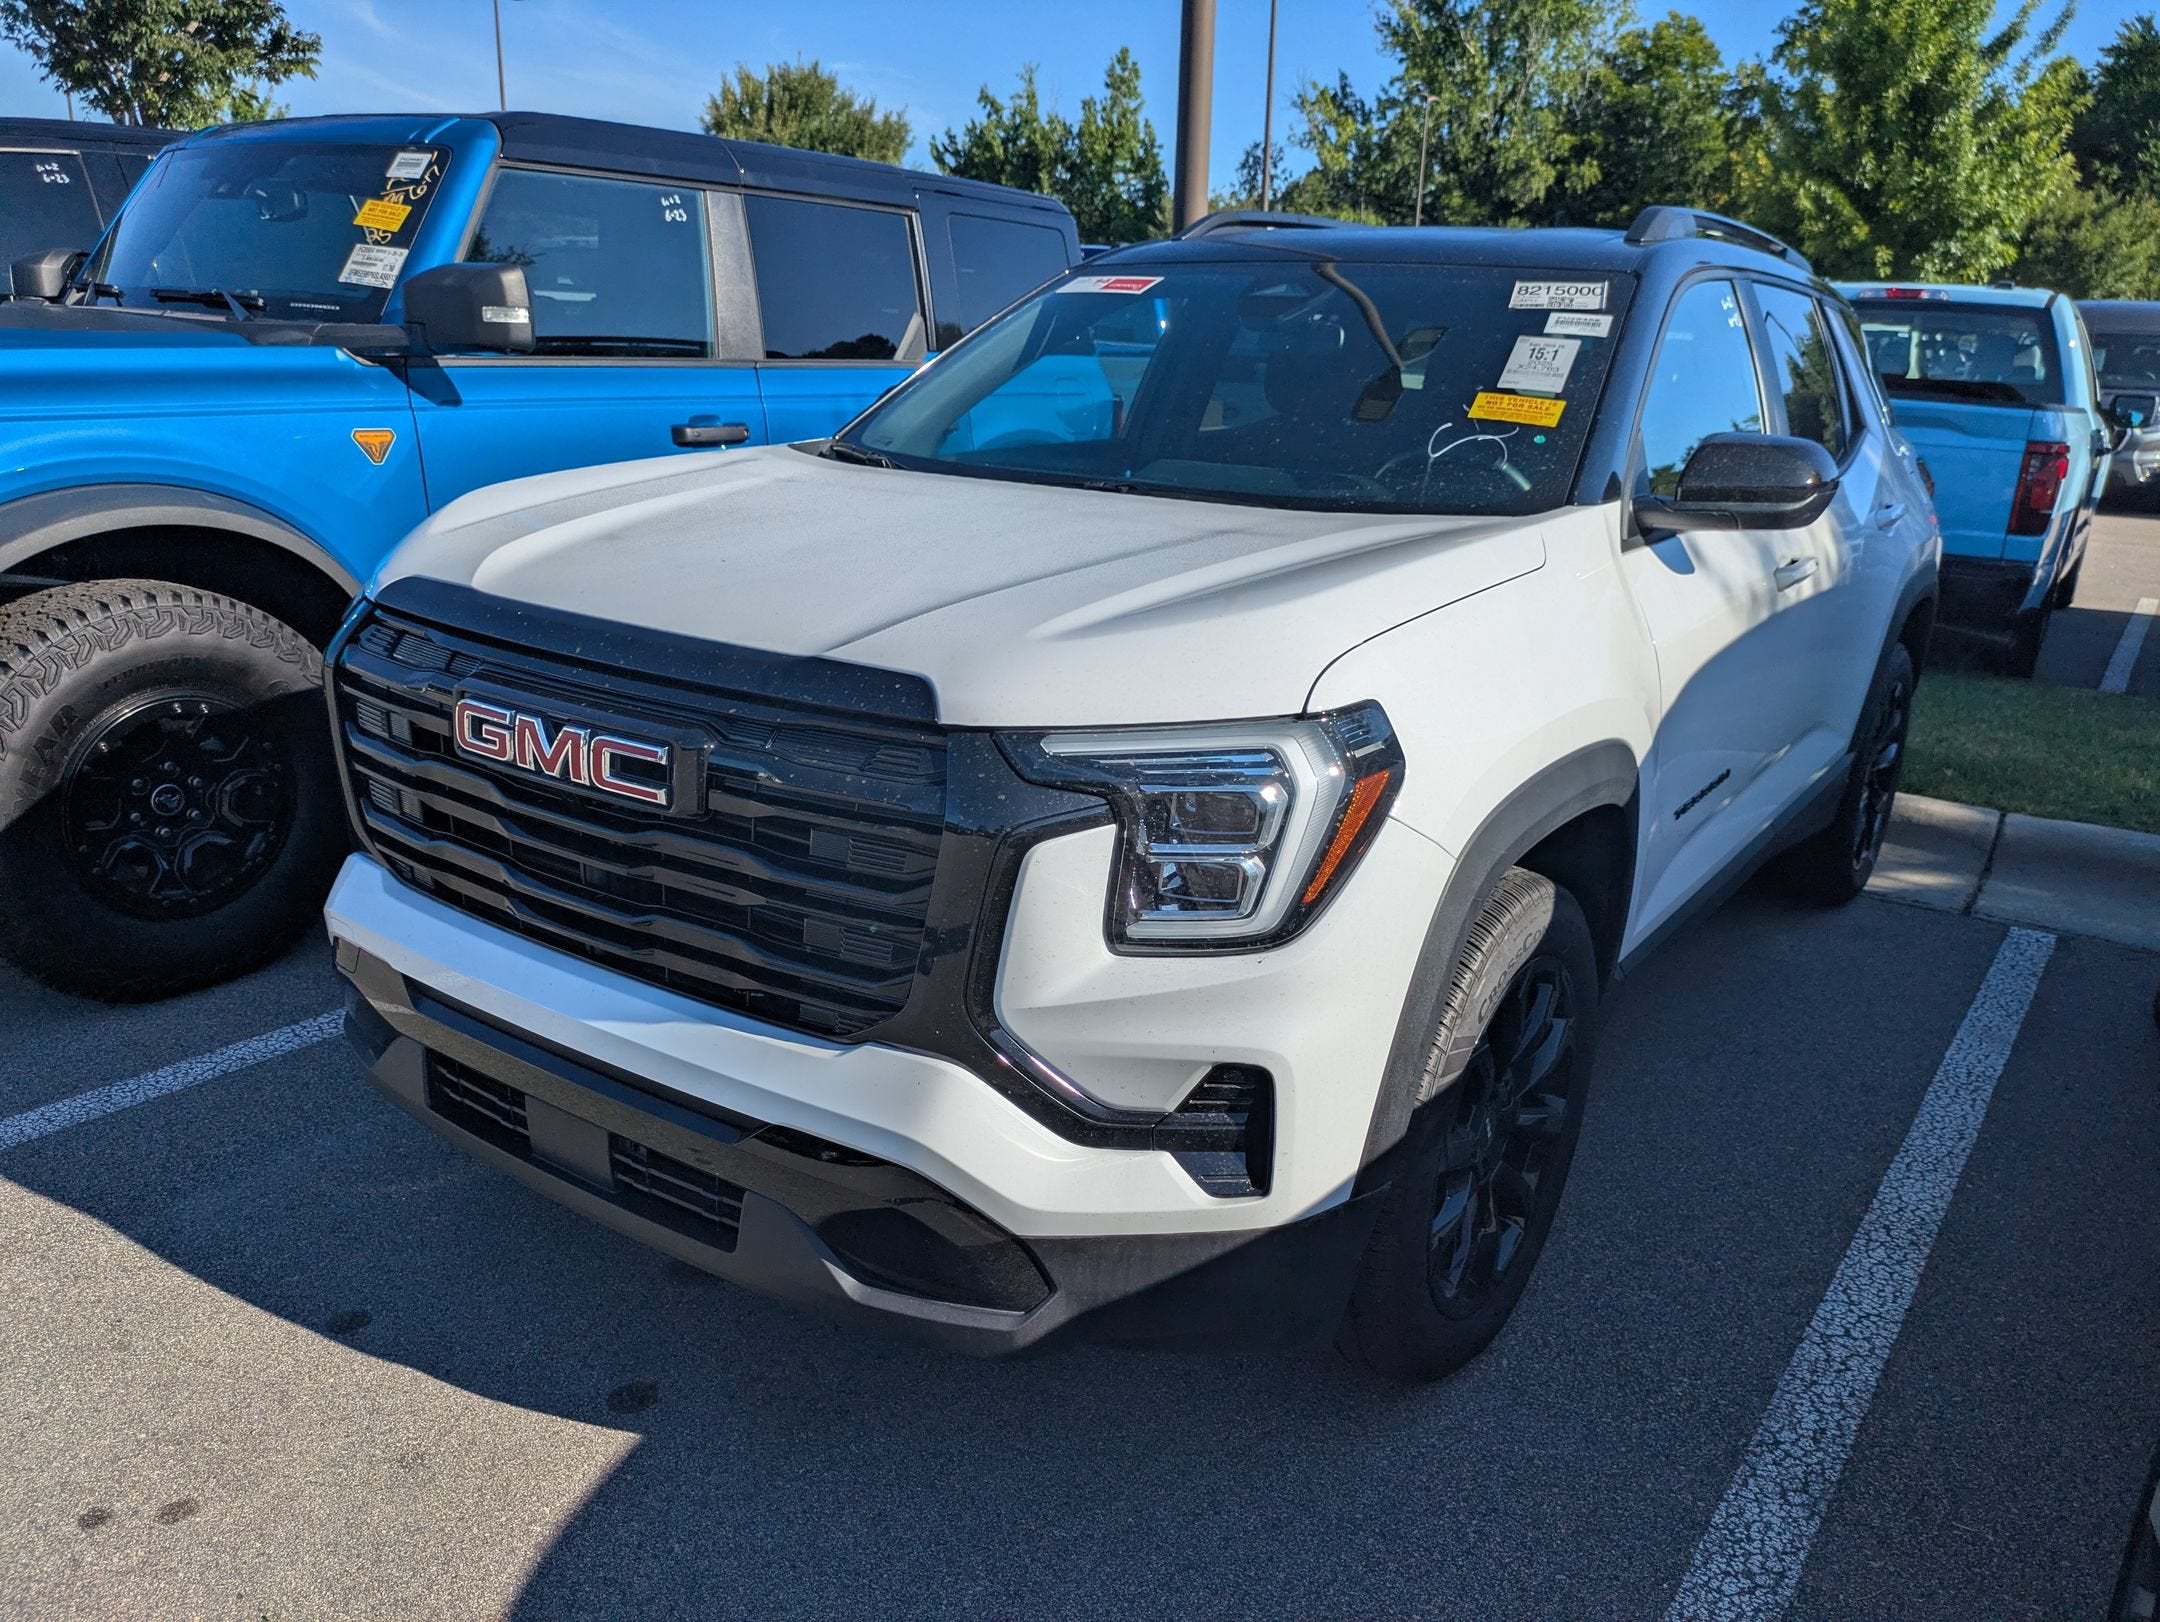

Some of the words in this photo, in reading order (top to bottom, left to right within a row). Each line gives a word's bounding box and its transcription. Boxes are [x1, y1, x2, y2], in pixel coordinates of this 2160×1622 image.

[1529, 348, 1560, 362] 15:1
[1485, 399, 1504, 407] NOT
[1528, 404, 1551, 412] SALE
[1507, 396, 1546, 406] VEHICLE
[456, 699, 669, 806] GMC
